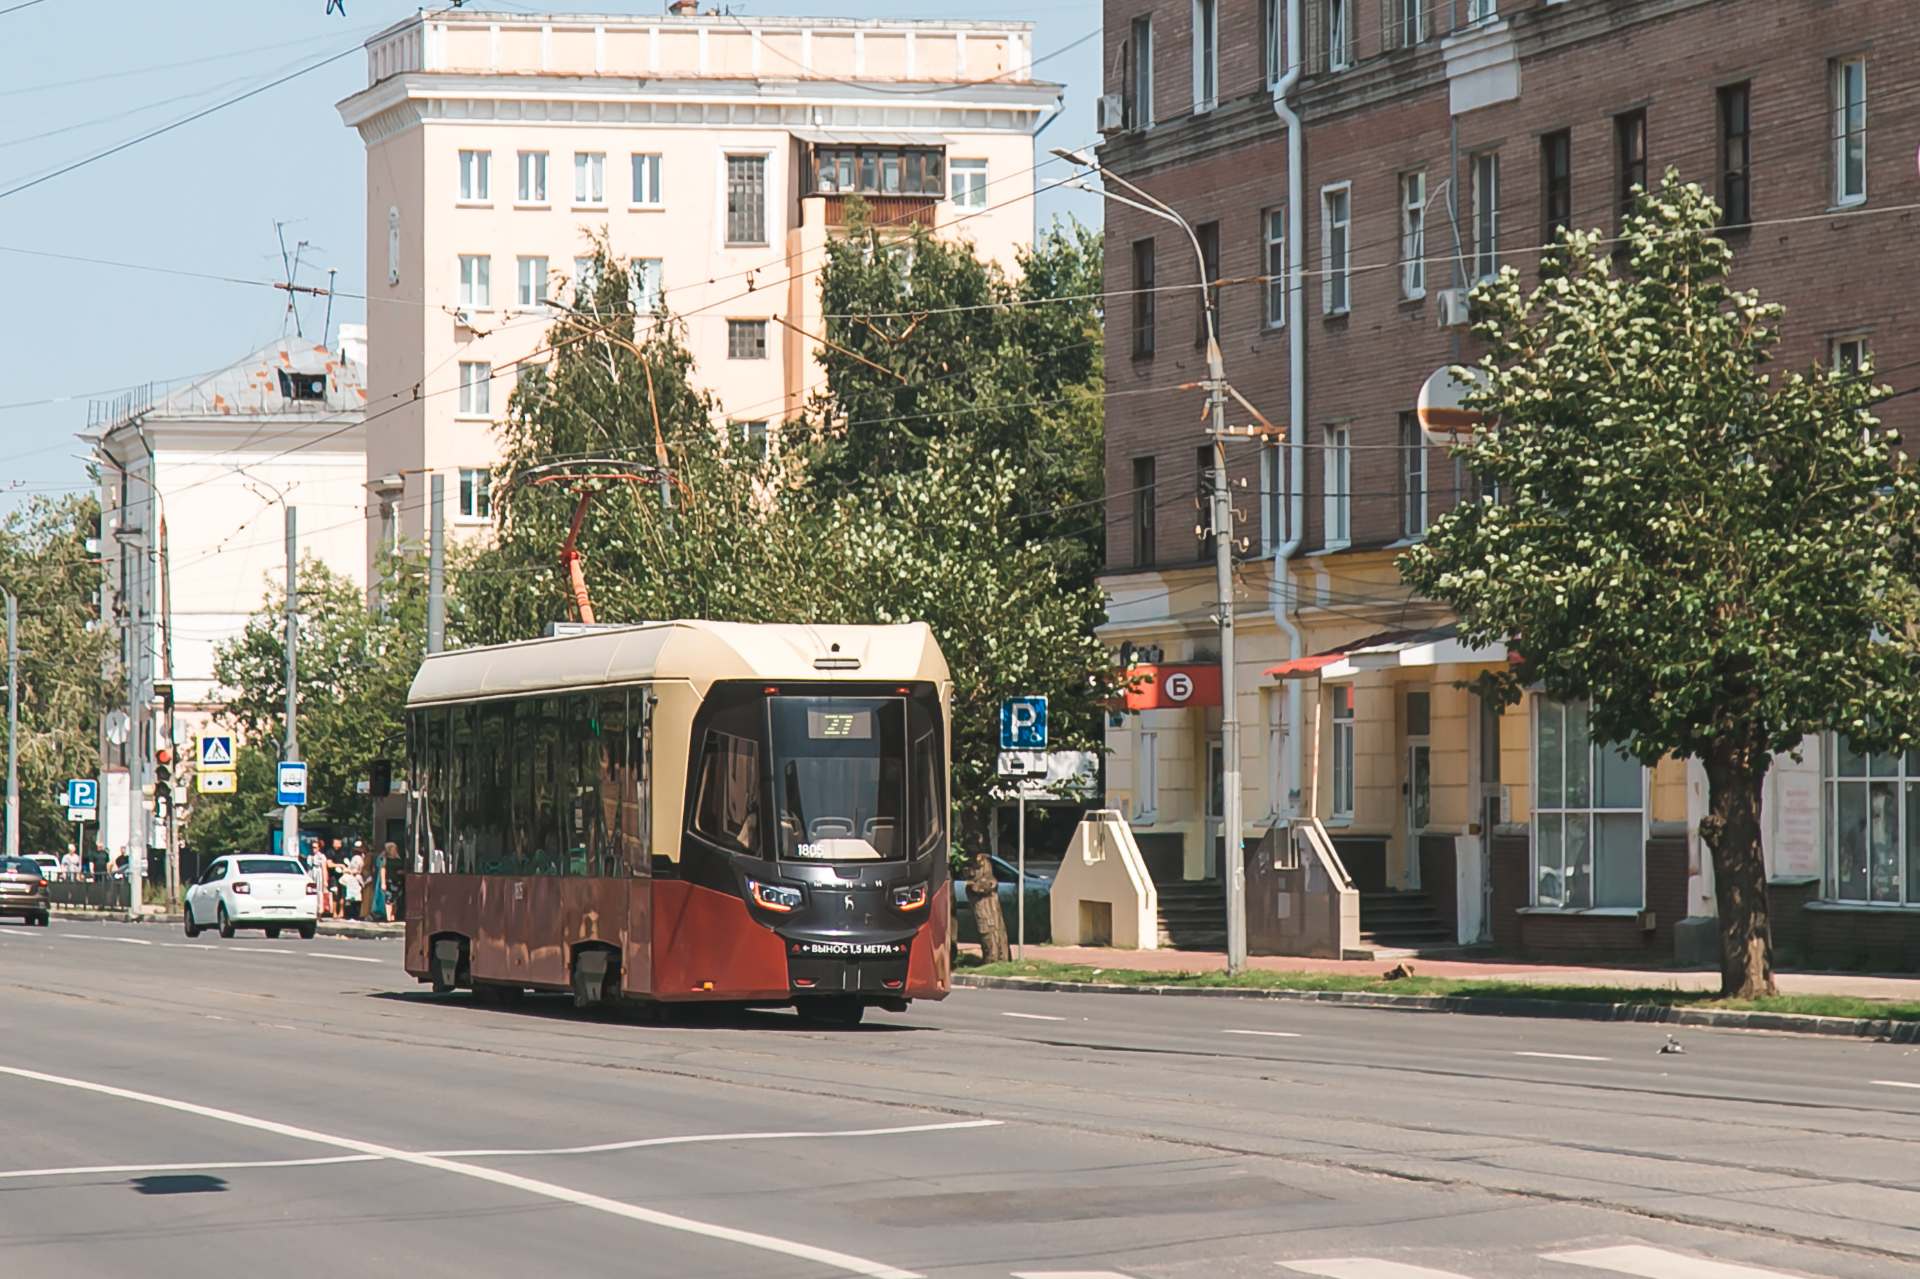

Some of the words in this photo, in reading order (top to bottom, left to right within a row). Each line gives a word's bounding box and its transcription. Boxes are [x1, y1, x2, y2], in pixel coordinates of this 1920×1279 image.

[1172, 677, 1188, 696] Б
[824, 714, 854, 735] 27
[1011, 703, 1037, 742] P
[74, 783, 91, 805] P
[797, 843, 824, 858] 1805
[811, 944, 848, 954] ВЫНОС
[863, 944, 892, 954] МЕТРА
